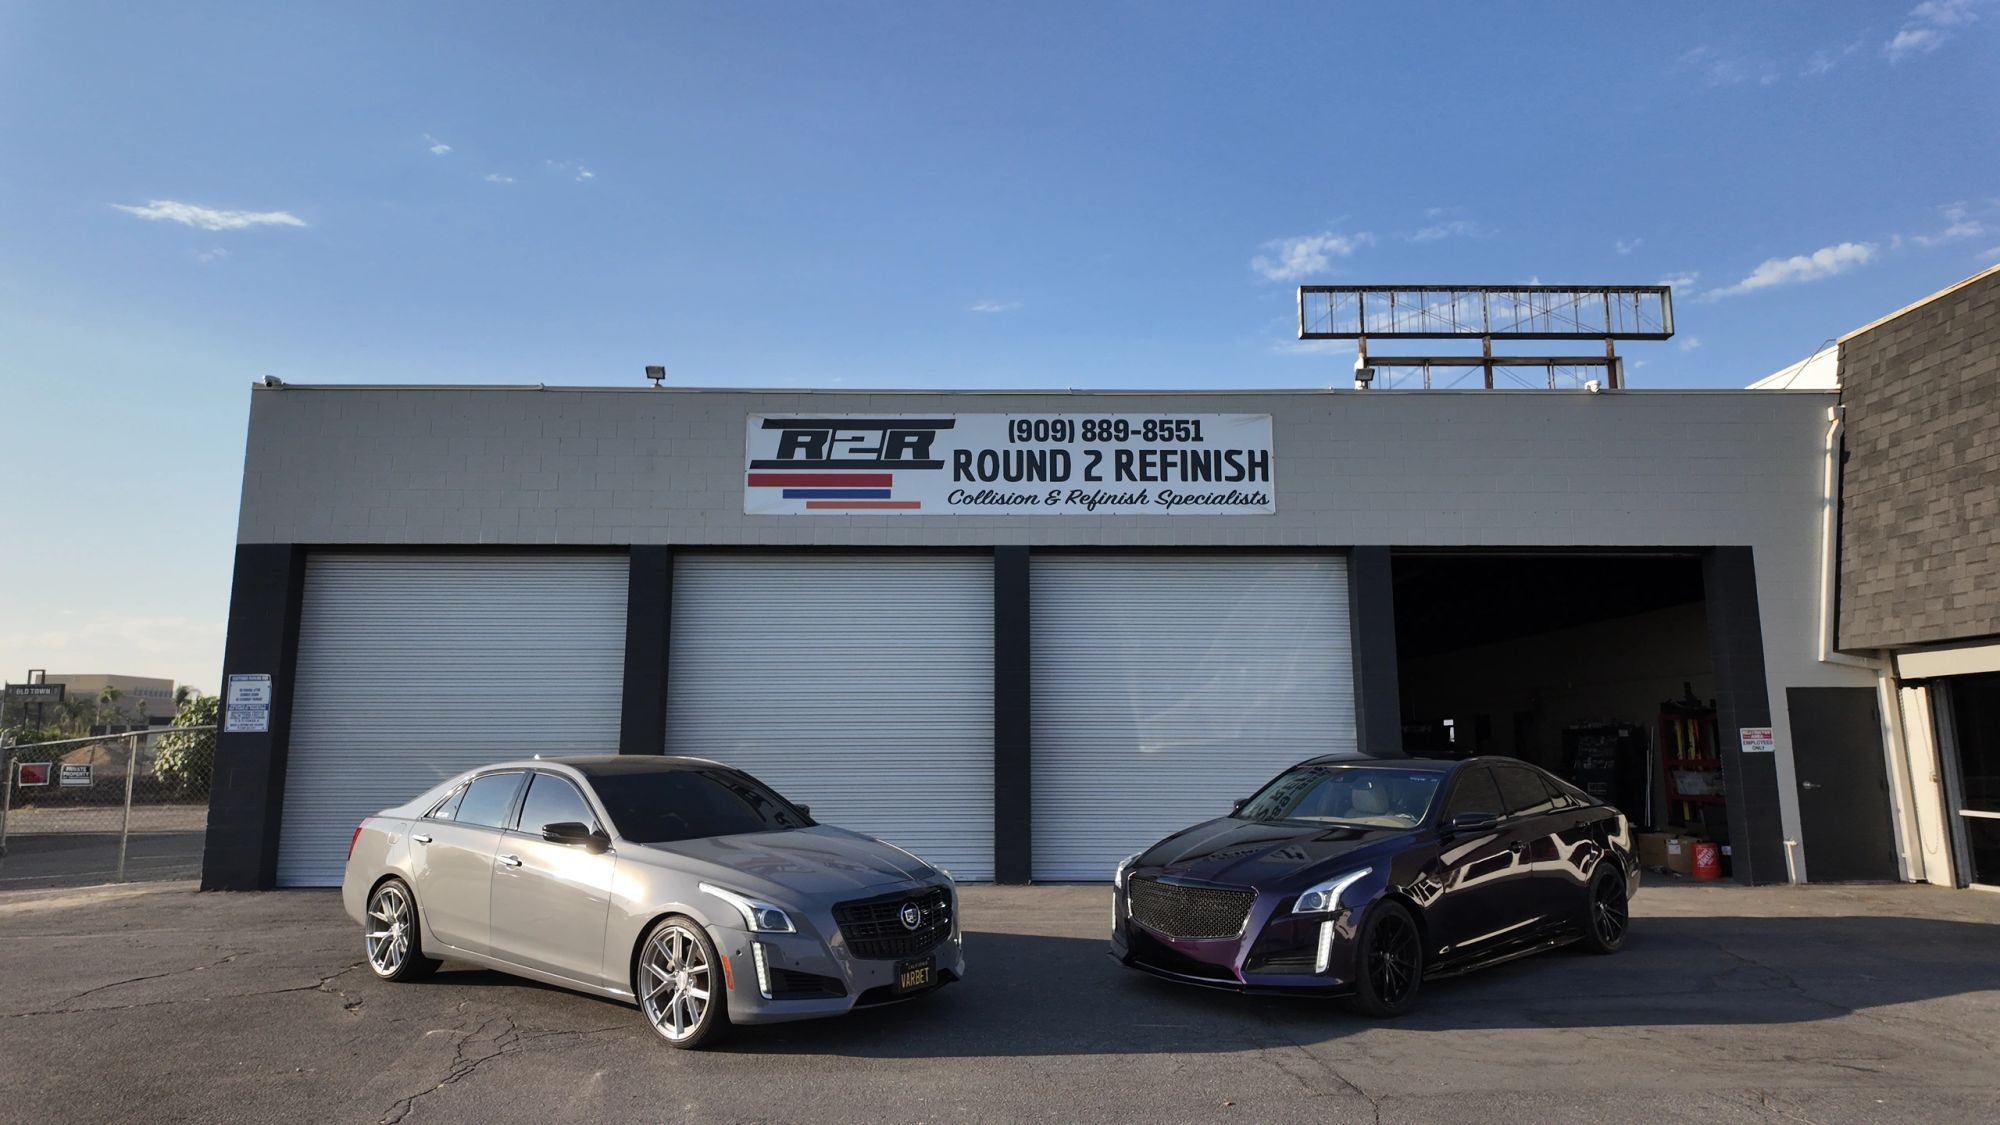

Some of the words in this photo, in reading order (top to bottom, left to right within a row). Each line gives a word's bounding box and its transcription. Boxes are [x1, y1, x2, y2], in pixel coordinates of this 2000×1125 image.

[1008, 419, 1075, 444] (909)
[1081, 419, 1204, 443] 889-8551
[776, 429, 936, 460] R2R
[953, 449, 1072, 483] ROUND
[1083, 449, 1103, 482] 2
[1114, 449, 1269, 483] REFINISH
[947, 489, 1041, 506] Collision
[1044, 489, 1062, 506] &
[1065, 489, 1150, 512] Refinish
[1154, 489, 1270, 510] Specialists
[901, 967, 928, 988] VARBET
